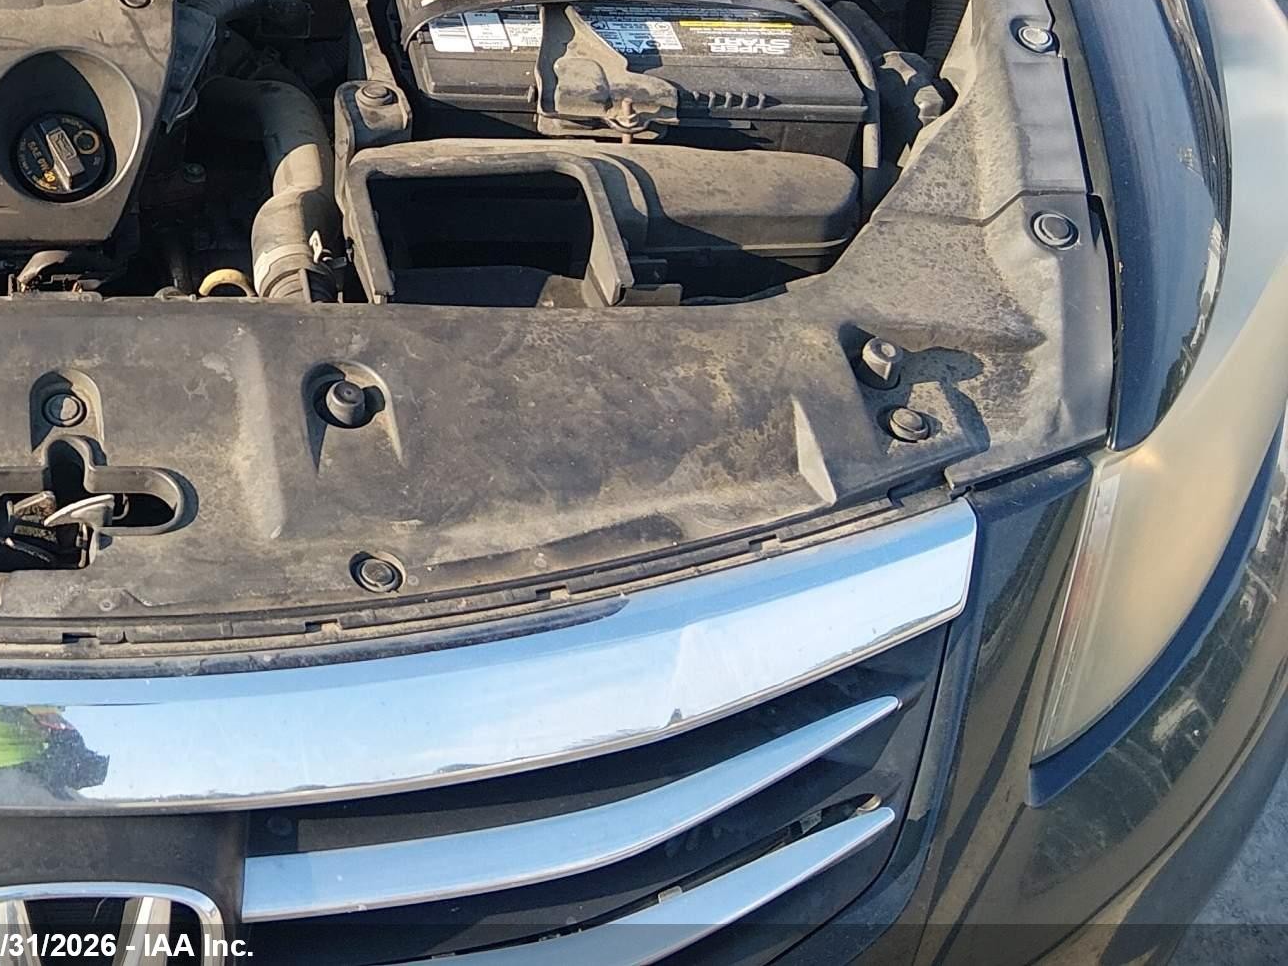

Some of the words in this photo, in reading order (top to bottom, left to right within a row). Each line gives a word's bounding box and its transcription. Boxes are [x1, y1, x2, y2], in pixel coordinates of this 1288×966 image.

[708, 37, 790, 48] START
[711, 45, 785, 55] SUPER
[27, 140, 43, 158] SAE
